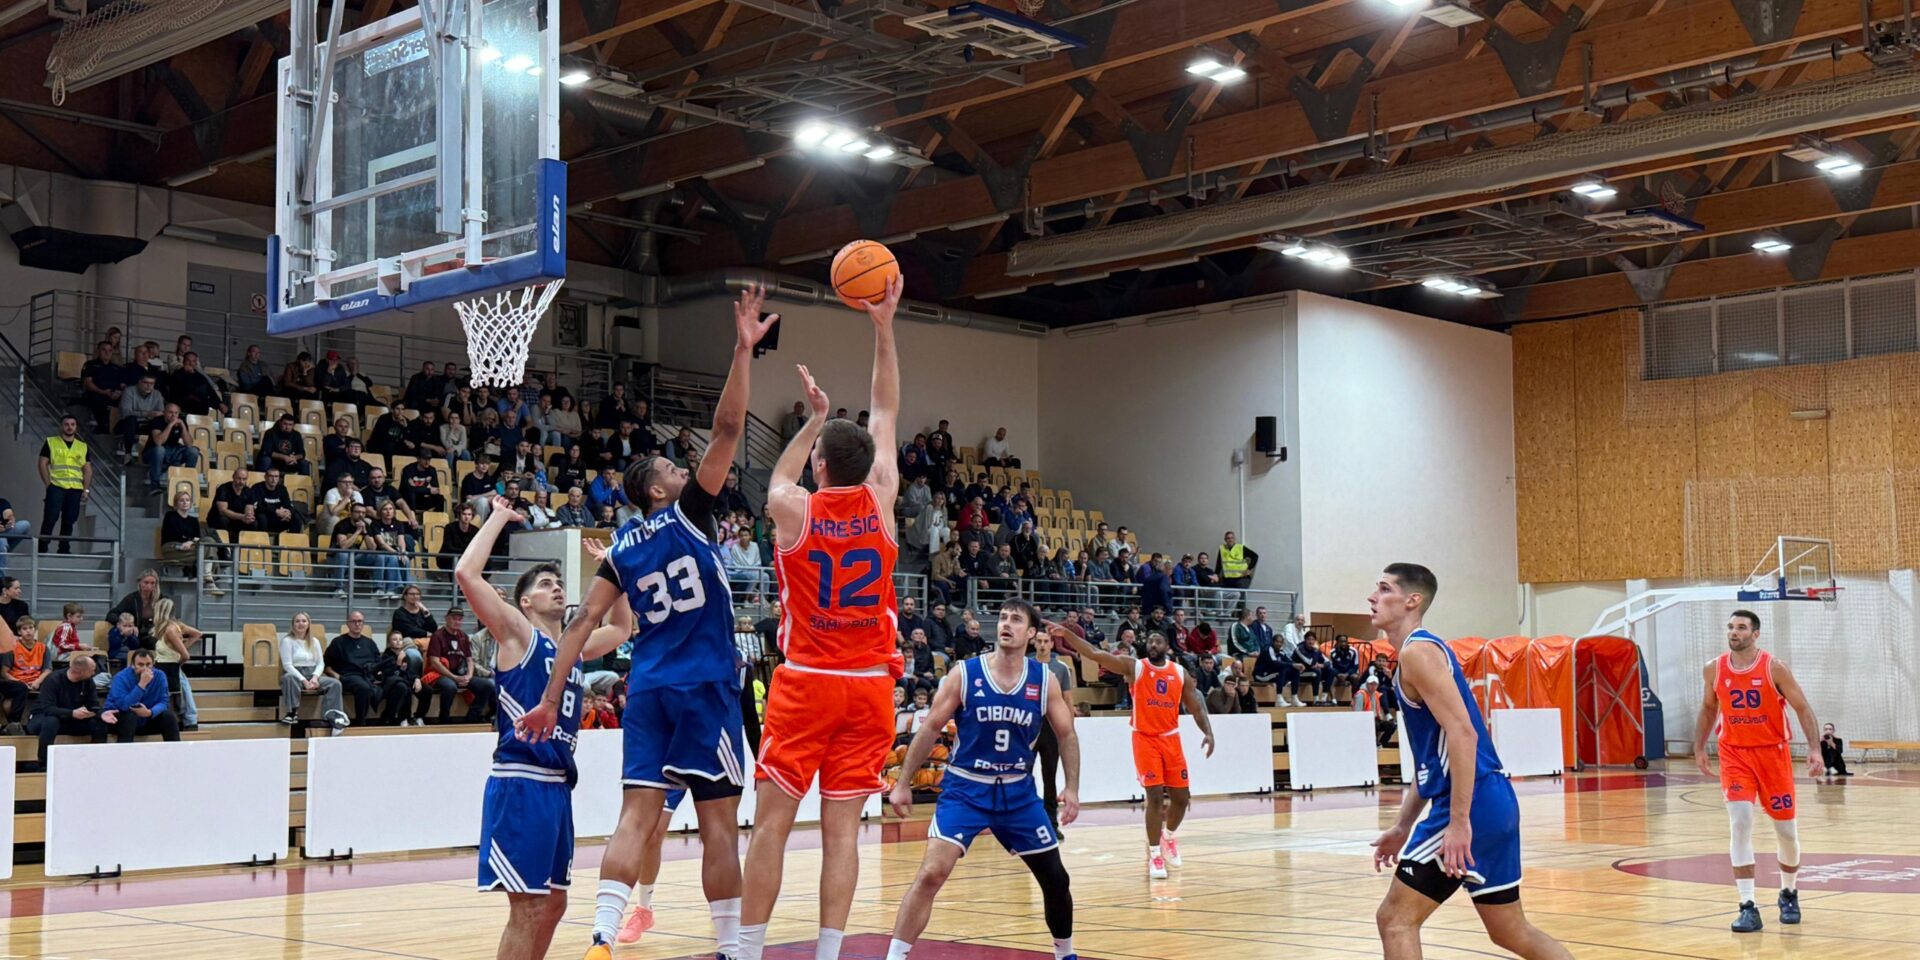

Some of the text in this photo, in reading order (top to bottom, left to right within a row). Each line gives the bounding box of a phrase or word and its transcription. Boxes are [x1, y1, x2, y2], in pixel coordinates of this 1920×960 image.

[551, 194, 560, 254] elan
[340, 299, 370, 311] elan
[810, 510, 879, 538] KREŠIĆ
[636, 555, 706, 624] 33
[807, 547, 882, 609] 12
[561, 689, 576, 718] 8
[1729, 689, 1762, 709] 20
[976, 705, 1033, 727] CIBONA
[994, 729, 1010, 752] 9
[1769, 793, 1793, 810] 20
[1036, 825, 1052, 844] 9
